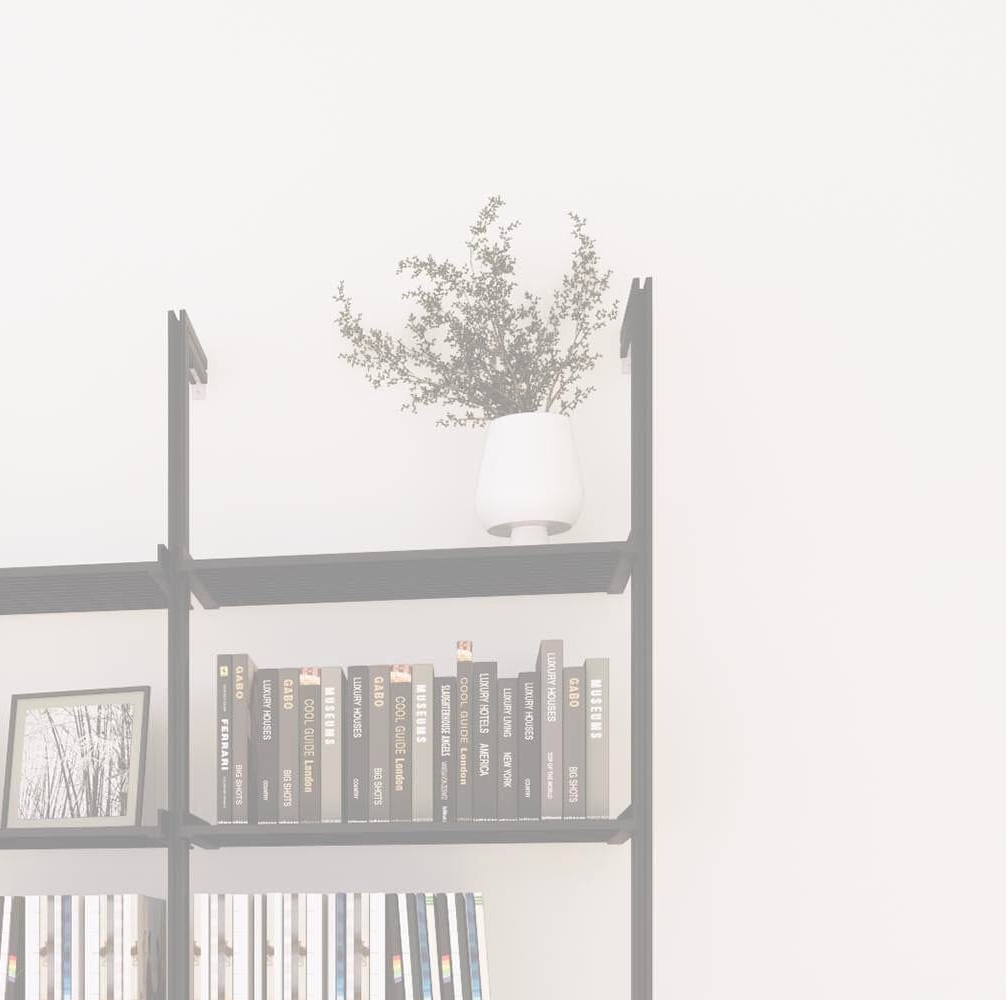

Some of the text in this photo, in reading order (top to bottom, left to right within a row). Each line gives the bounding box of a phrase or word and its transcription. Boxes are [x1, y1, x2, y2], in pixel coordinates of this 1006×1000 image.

[235, 666, 244, 699] GABO
[263, 679, 272, 741] LUXURY HOUSES
[283, 679, 294, 710] GABO
[353, 677, 362, 739] LUXURY HOUSES
[373, 676, 384, 707] GABO
[441, 684, 450, 734] SLAUGHTERHOUSE
[524, 682, 534, 741] LUXURY HOUSES
[547, 652, 557, 722] LUXURY HOUSES
[569, 678, 579, 708] GABO
[591, 679, 602, 739] MUSEUMS
[325, 687, 335, 745] MUSEUMS
[416, 684, 426, 743] MUSEUMS
[460, 677, 469, 785] COOL GUIDE London
[479, 673, 489, 776] LUXURY HOTELS AMERICA
[503, 688, 512, 788] LUXURY LIVING NEW YORK
[220, 718, 230, 771] FERRARI
[304, 698, 314, 793] COOL GUIDE London
[395, 696, 405, 792] COOL GUIDE London
[441, 735, 450, 757] ANGELS
[235, 764, 243, 806] BIG SHOTS
[283, 770, 292, 808] BIG SHOTS
[373, 767, 382, 806] BIG SHOTS
[569, 766, 578, 803] BIG SHOTS
